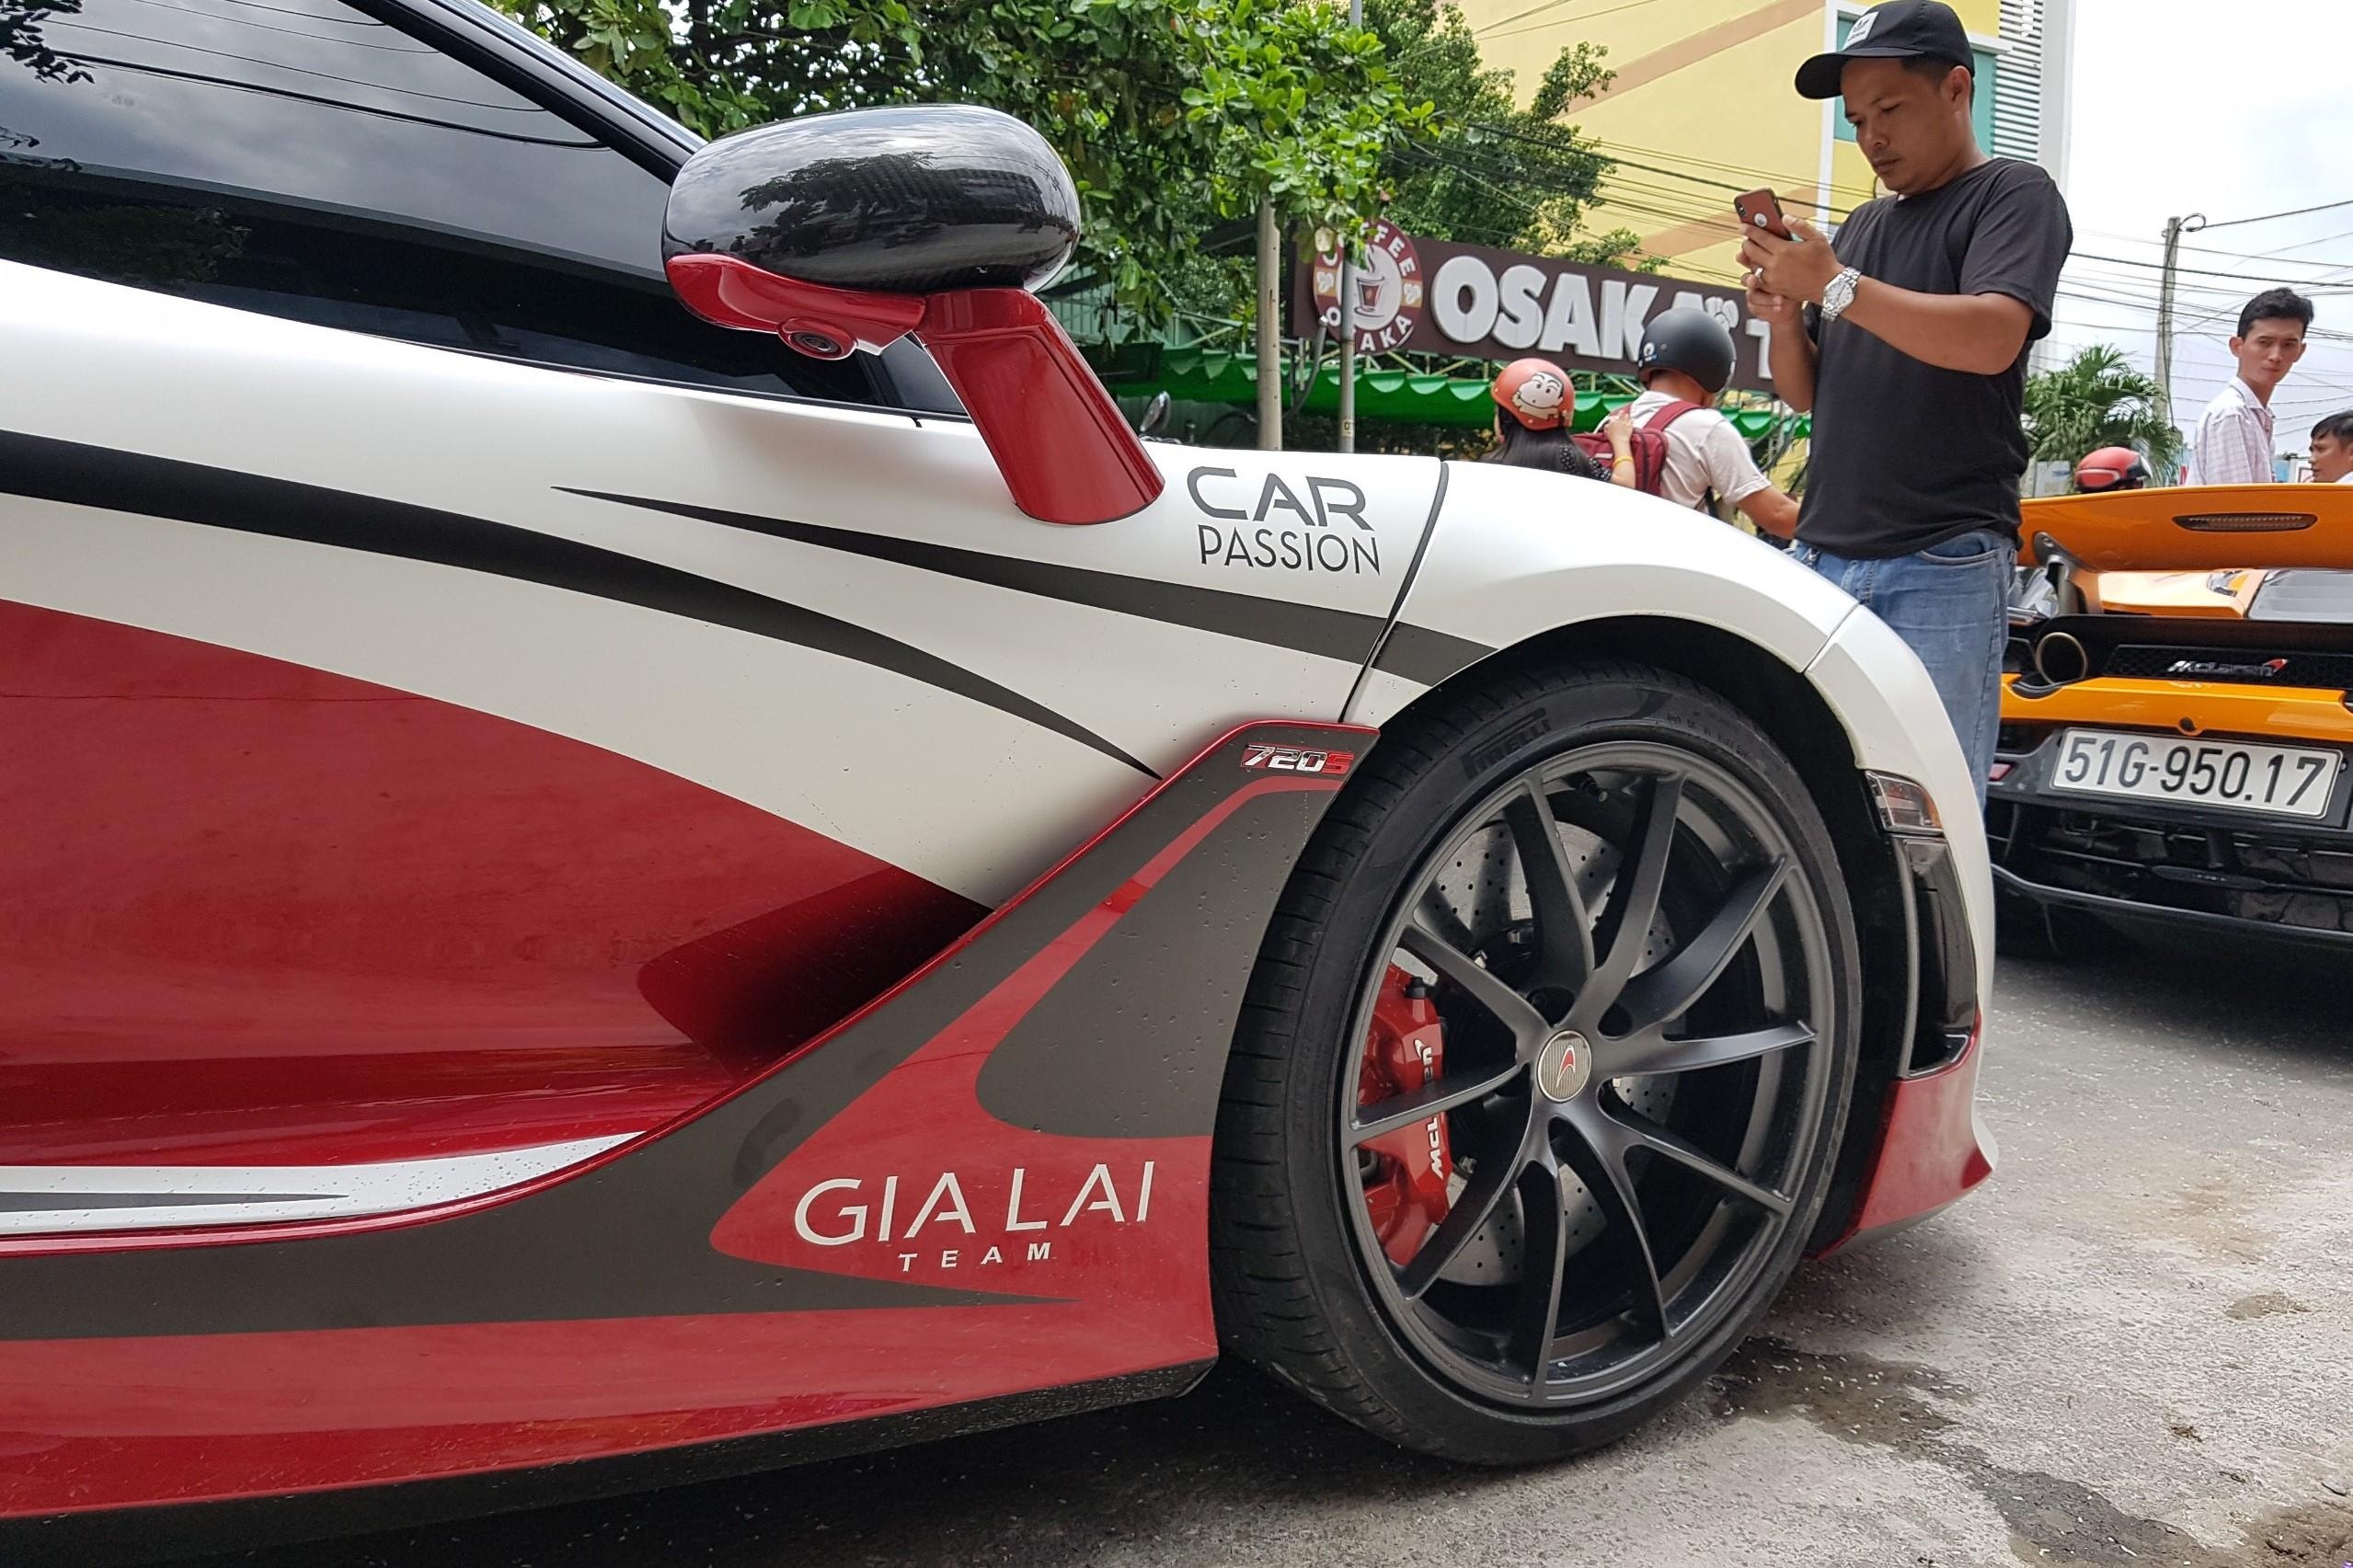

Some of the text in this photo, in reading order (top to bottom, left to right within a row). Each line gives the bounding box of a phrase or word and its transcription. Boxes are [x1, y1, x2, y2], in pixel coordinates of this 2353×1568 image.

[1326, 306, 1412, 351] OAKA
[1430, 256, 1704, 361] OSAK
[1187, 465, 1375, 532] CAR
[1197, 523, 1381, 577] PASSION
[1244, 744, 1355, 775] 720S
[2064, 737, 2327, 807] 51G-950.17
[794, 1161, 1154, 1246] GIA LAI
[898, 1242, 1051, 1273] TEAM
